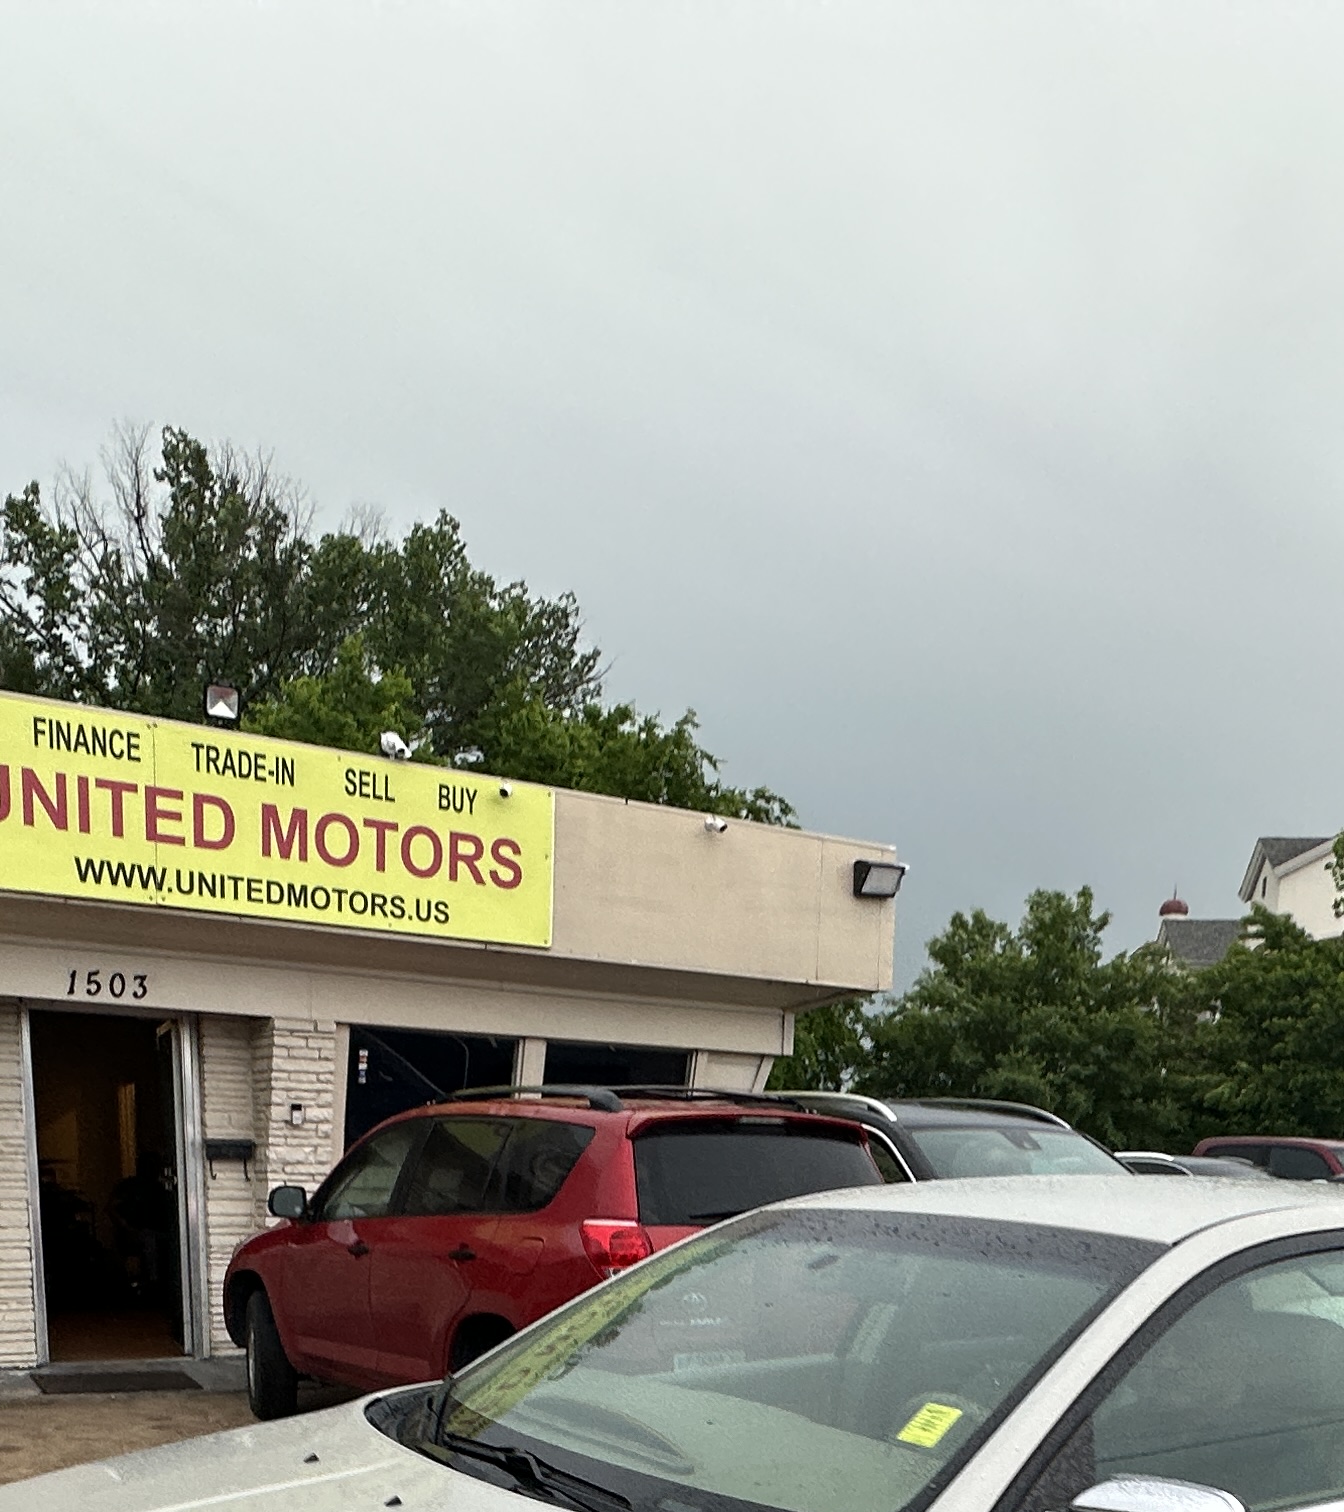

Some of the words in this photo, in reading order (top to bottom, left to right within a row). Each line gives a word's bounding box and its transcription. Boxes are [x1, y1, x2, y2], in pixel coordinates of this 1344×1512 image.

[32, 716, 141, 762] FINANCE
[191, 741, 296, 787] TRADE-IN
[344, 768, 396, 803] SELL
[438, 783, 478, 815] BUY
[261, 802, 523, 890] MOTORS
[74, 856, 450, 923] WWW.UNITEDMOTORS.US
[67, 969, 148, 999] 1503
